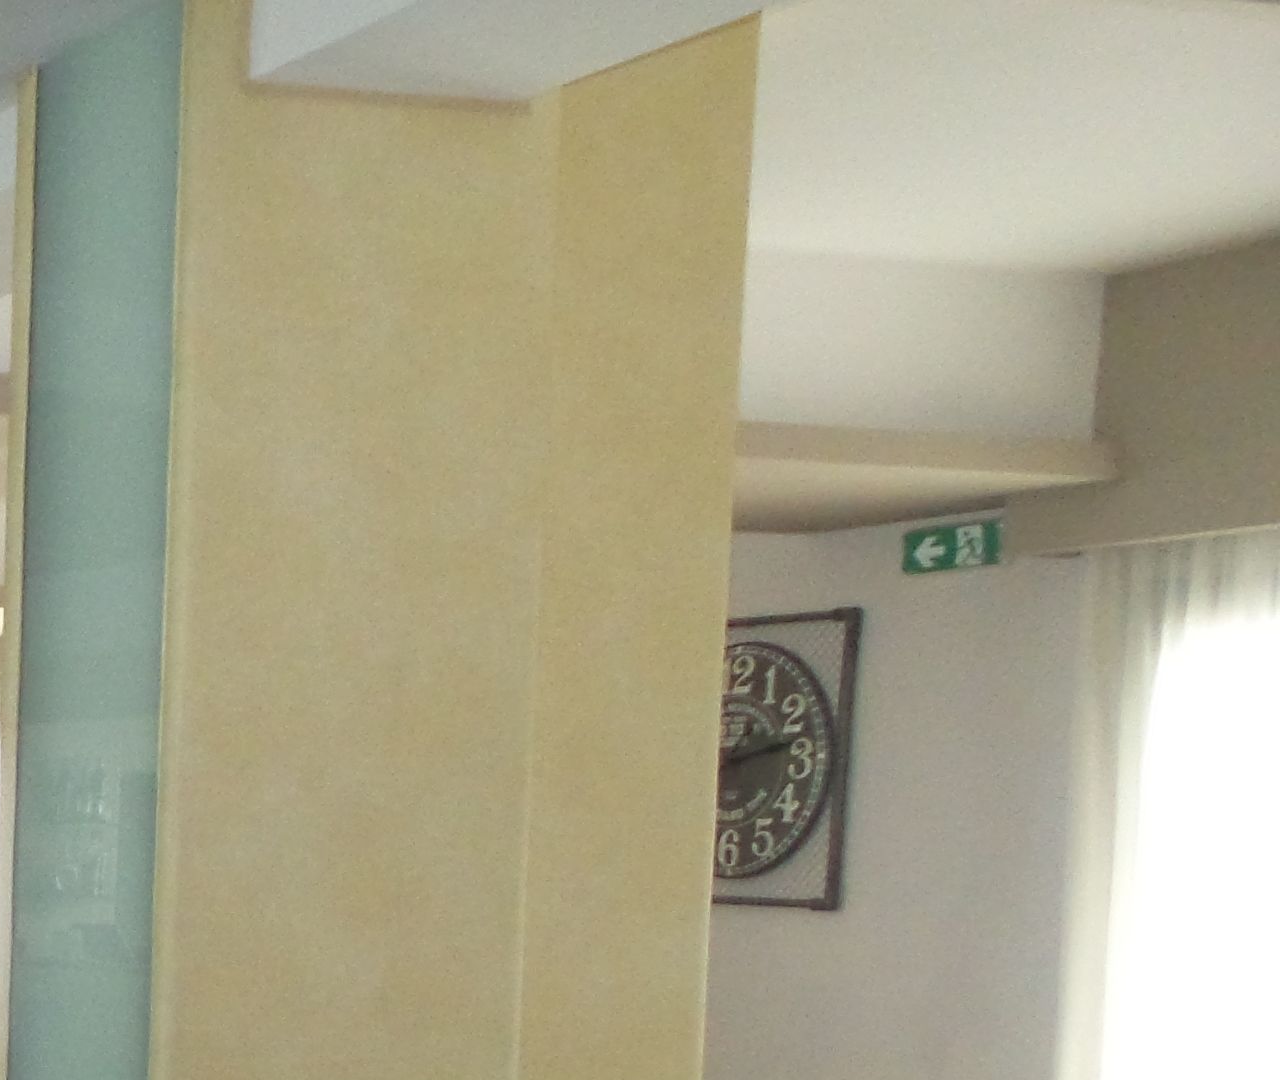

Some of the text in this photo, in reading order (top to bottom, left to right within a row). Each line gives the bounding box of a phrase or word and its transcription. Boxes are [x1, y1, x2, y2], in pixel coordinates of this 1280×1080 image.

[732, 655, 755, 694] 2
[763, 664, 776, 704] 1
[781, 693, 806, 734] 2
[788, 738, 813, 780] 3
[773, 783, 800, 823] 4
[718, 829, 739, 867] 6
[751, 818, 774, 857] 5
